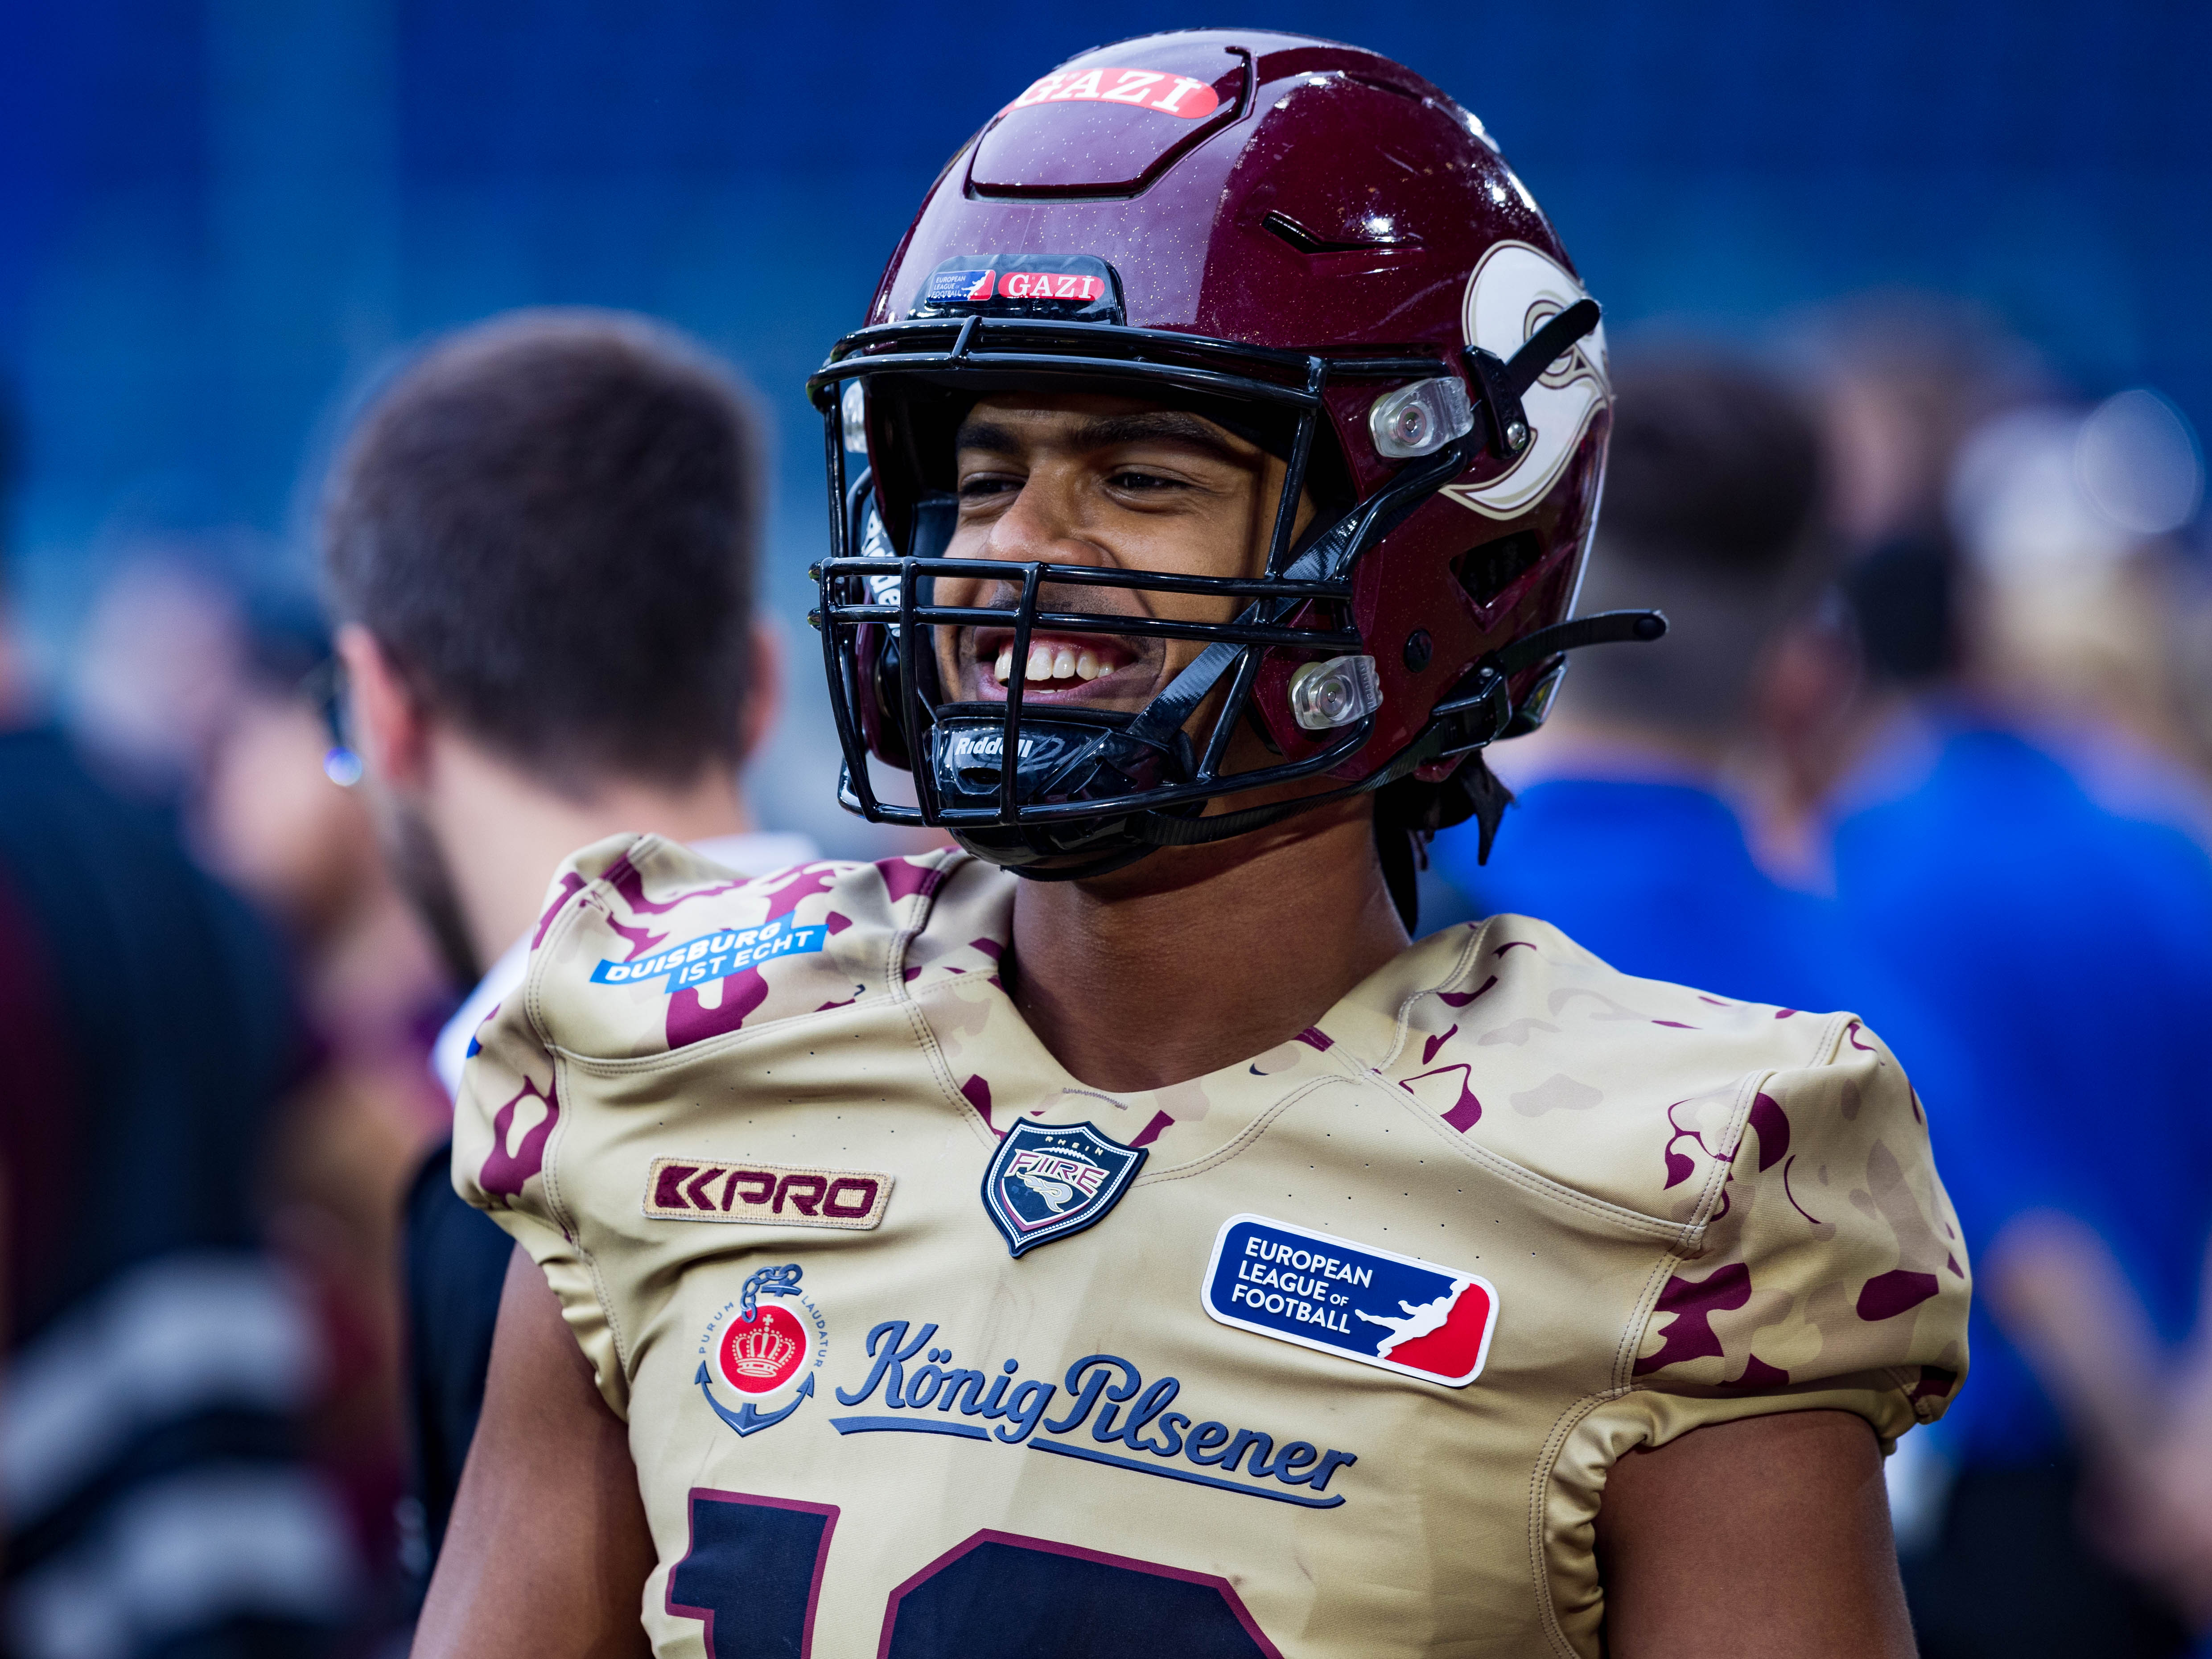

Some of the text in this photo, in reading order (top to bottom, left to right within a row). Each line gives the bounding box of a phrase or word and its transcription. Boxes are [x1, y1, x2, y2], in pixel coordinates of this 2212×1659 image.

[955, 737, 1034, 758] Riddll
[605, 922, 781, 981] DUISBURG
[679, 930, 814, 984] IST ECHT
[1045, 1136, 1104, 1156] RHEIN
[1004, 1149, 1110, 1199] FIRE
[1238, 1260, 1349, 1307] LEAGUE OF
[1245, 1236, 1373, 1288] EUROPEAN
[698, 1301, 734, 1354] PURUM
[801, 1295, 828, 1368] LAUDATUR
[1232, 1284, 1351, 1334] FOOTBALL
[835, 1320, 1358, 1492] König Pilsener
